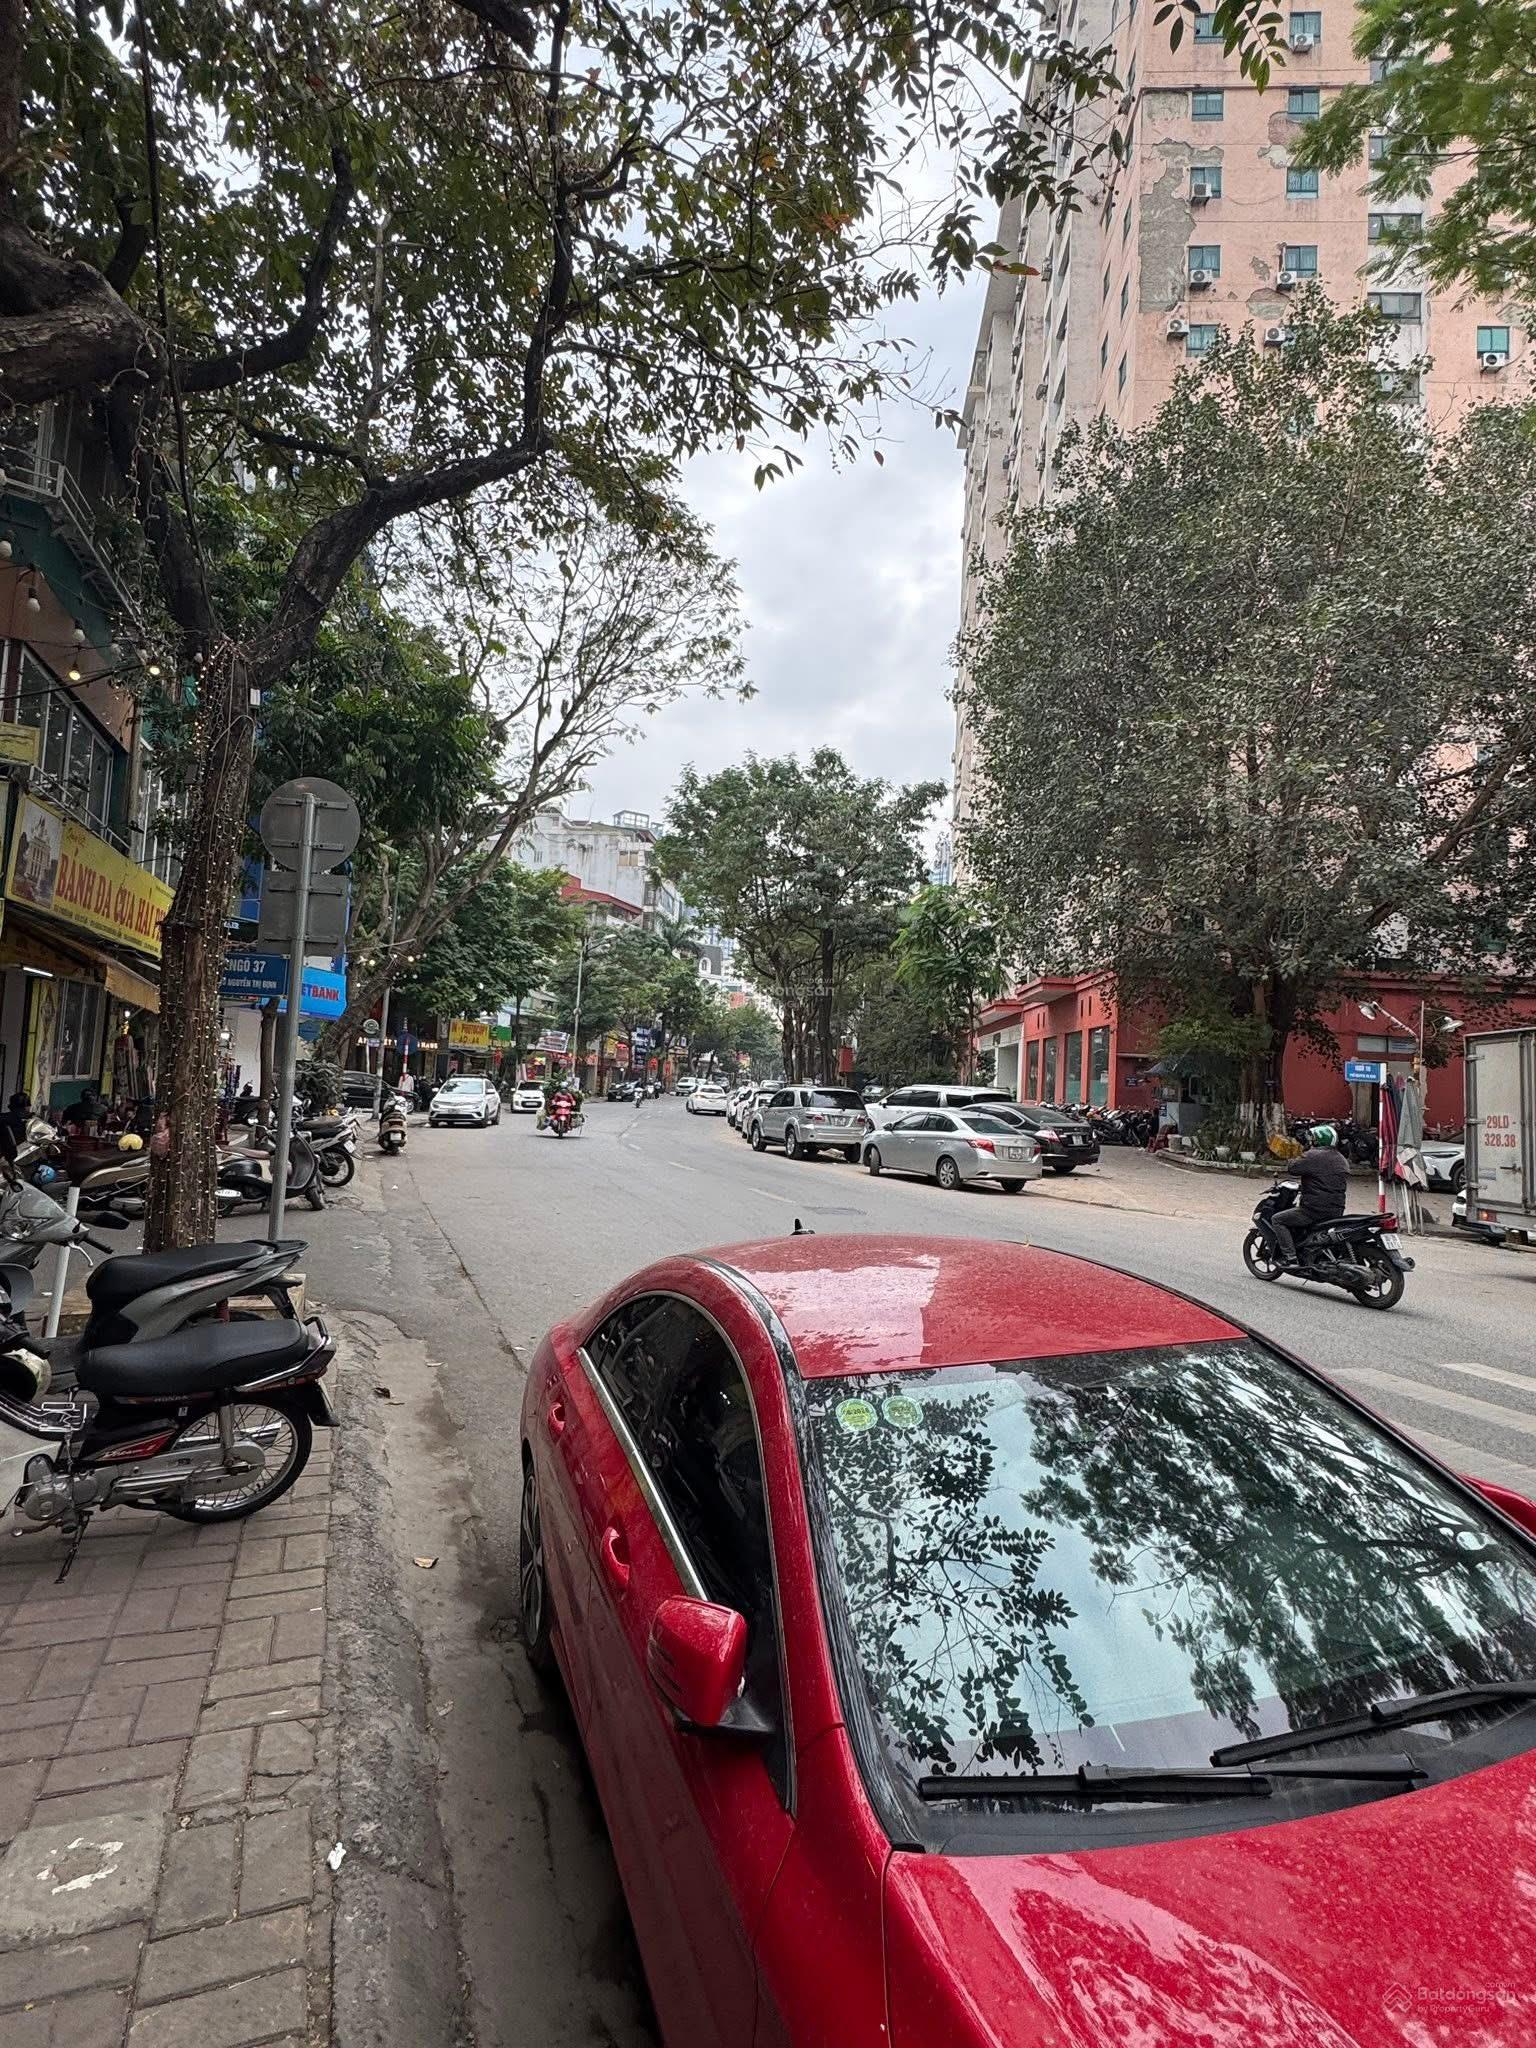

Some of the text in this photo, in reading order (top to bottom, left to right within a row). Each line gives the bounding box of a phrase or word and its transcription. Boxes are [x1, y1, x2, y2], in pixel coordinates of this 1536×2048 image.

[56, 848, 97, 911] BÁNH
[228, 956, 266, 974] NGÕ 37
[1484, 1133, 1516, 1148] 328.38
